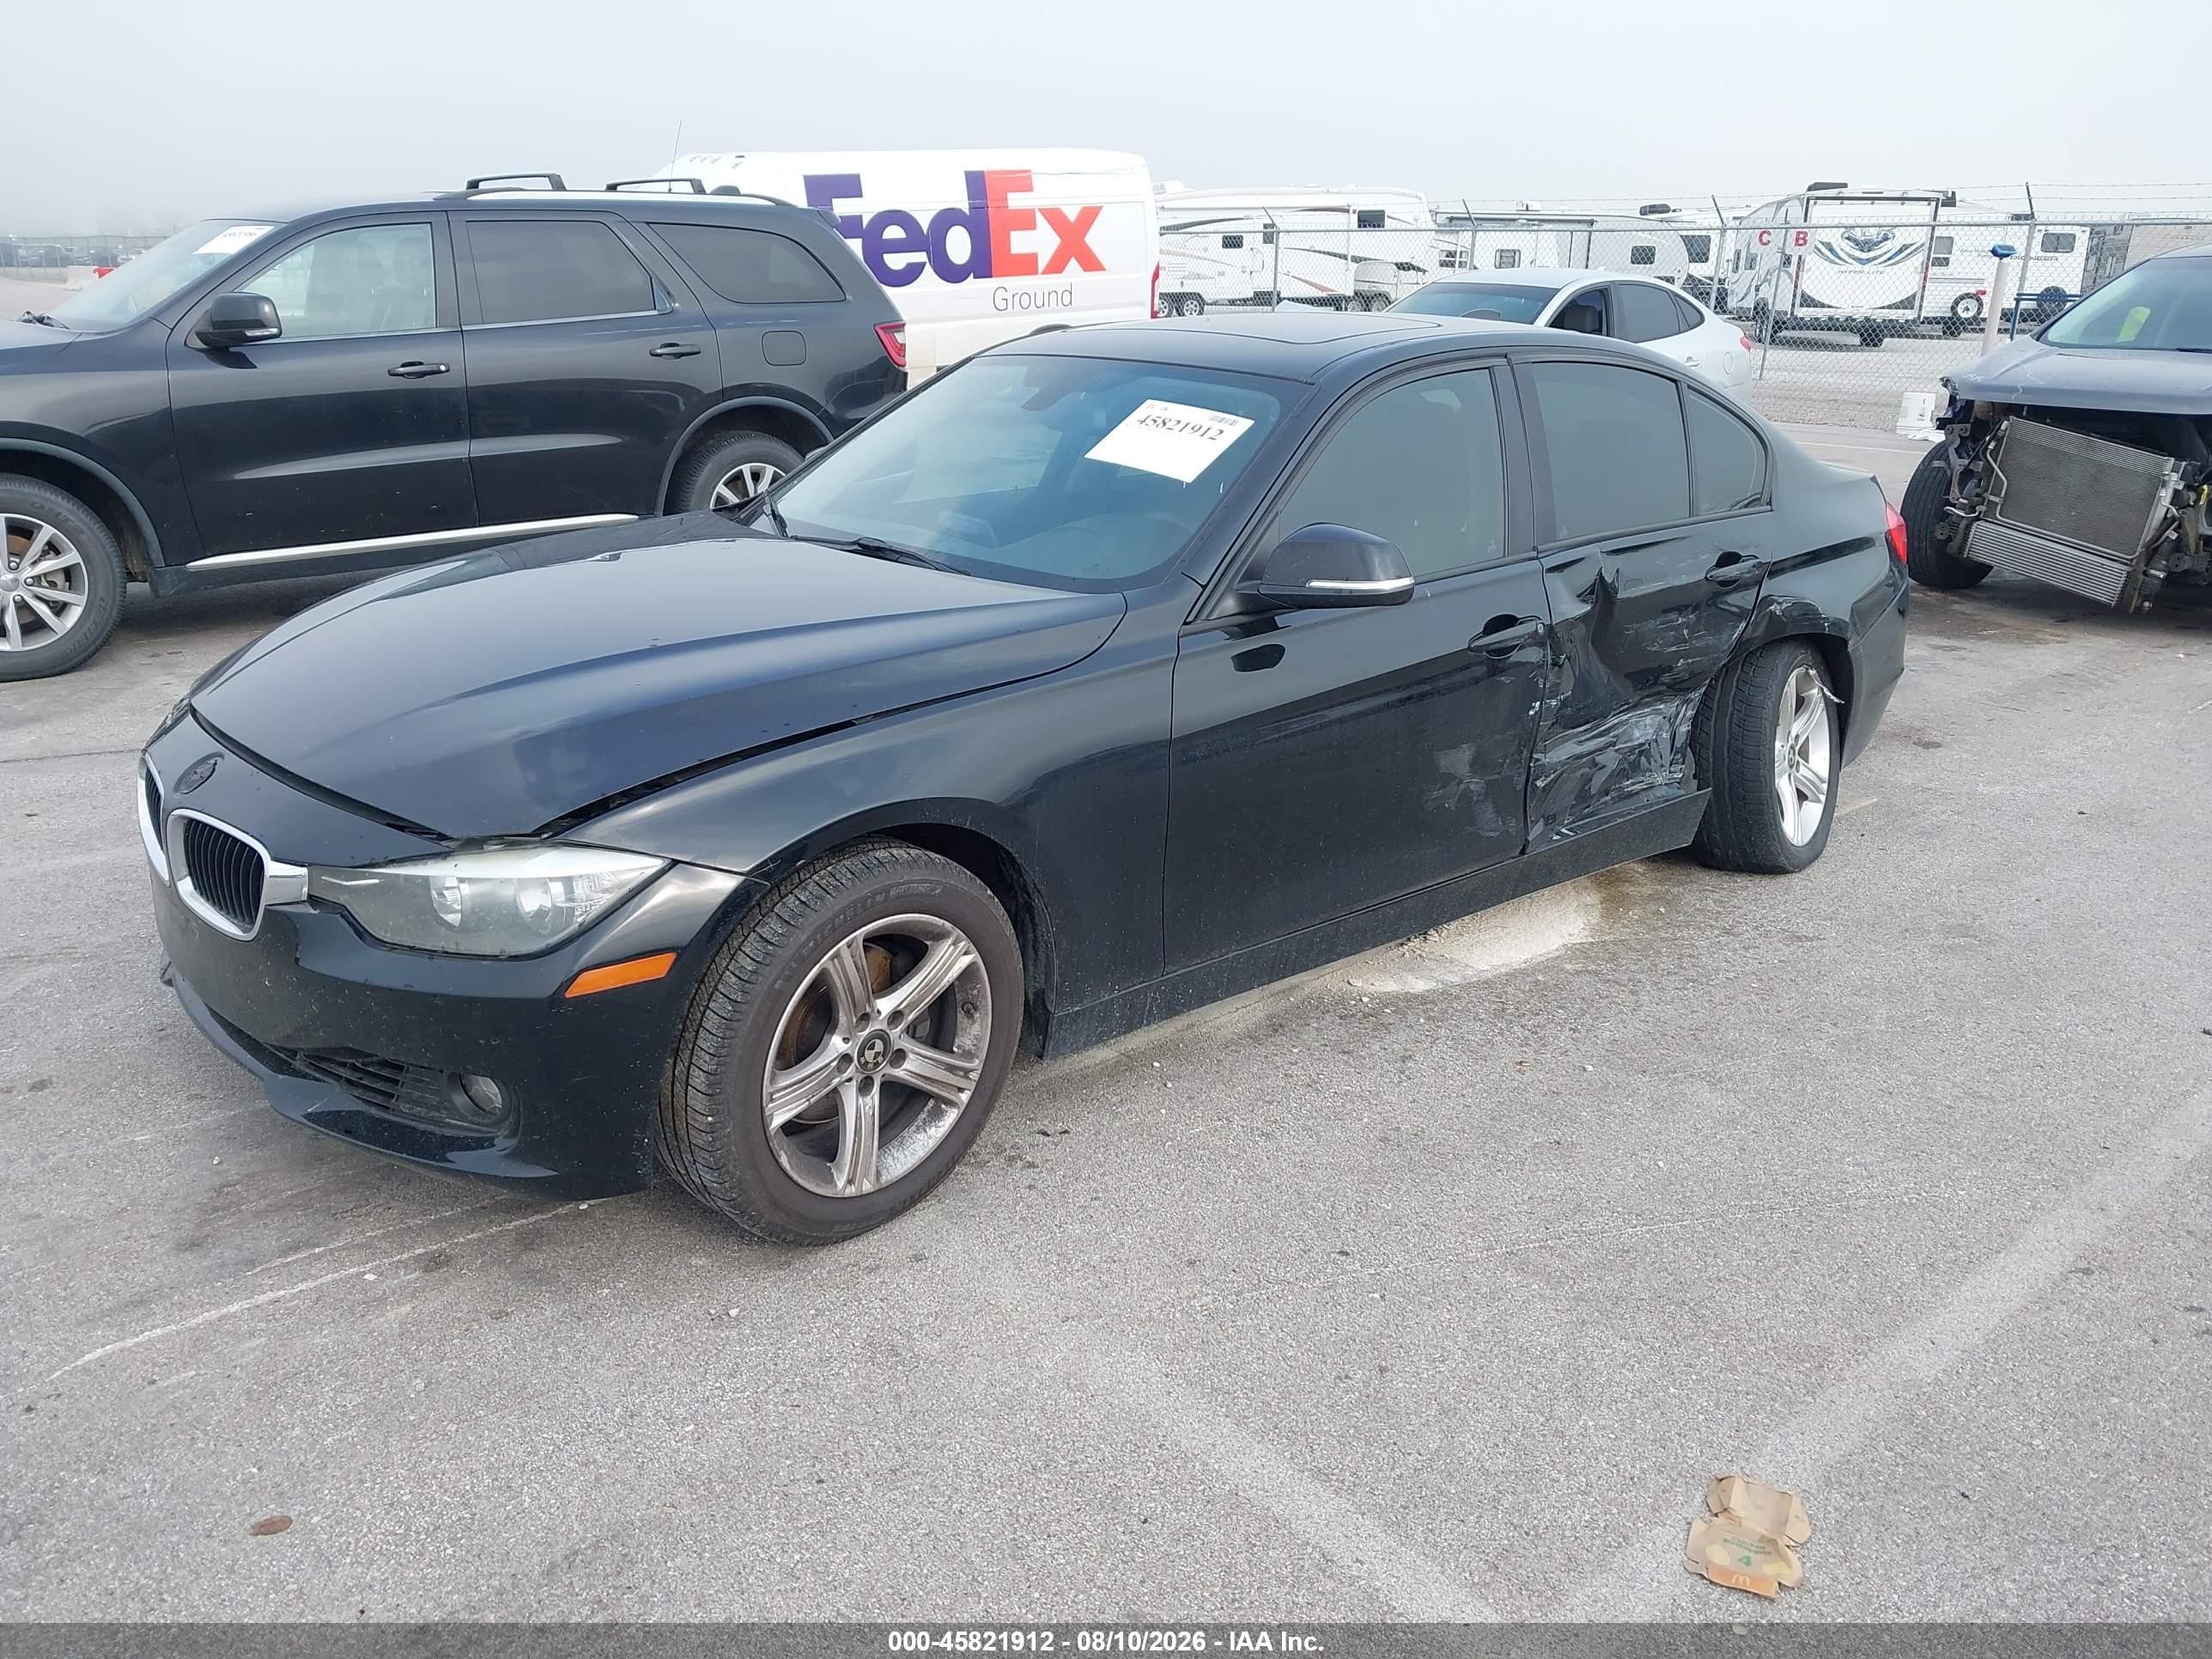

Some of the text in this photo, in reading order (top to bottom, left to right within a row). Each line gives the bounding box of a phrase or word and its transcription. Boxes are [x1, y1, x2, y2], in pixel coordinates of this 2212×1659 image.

[803, 169, 1107, 288] FedEx
[1758, 229, 1772, 246] C
[1794, 230, 1809, 247] B
[992, 282, 1073, 312] Ground
[1137, 414, 1224, 441] 45821912
